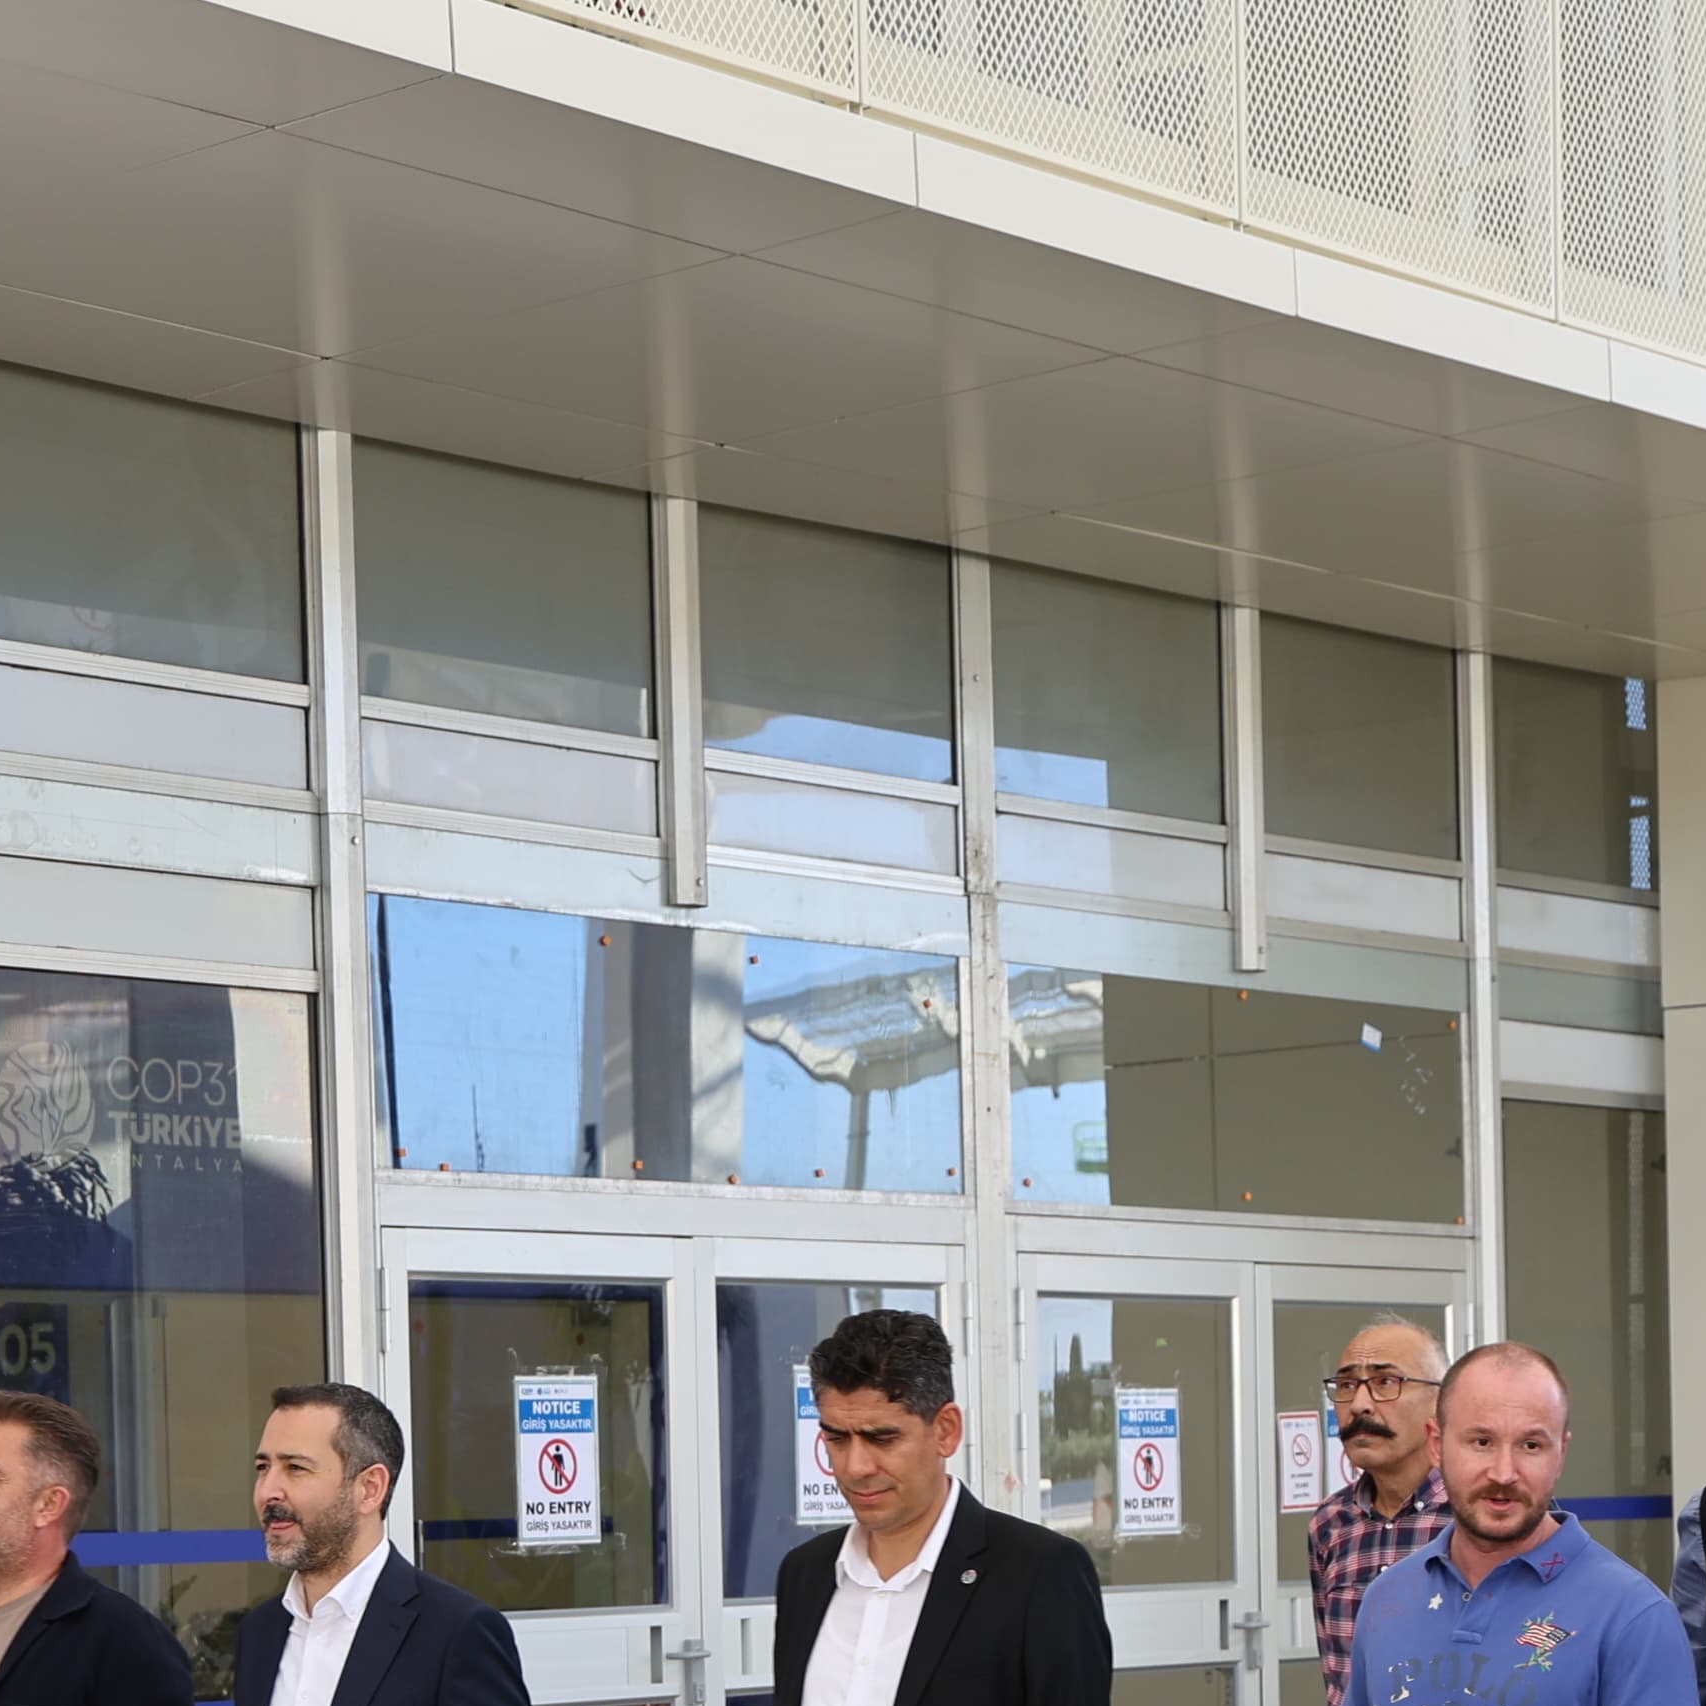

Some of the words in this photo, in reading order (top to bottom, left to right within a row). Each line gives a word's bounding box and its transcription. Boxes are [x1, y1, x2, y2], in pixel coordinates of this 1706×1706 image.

[532, 1401, 582, 1415] NOTICE
[1129, 1409, 1167, 1422] NOTICE
[521, 1416, 547, 1432] GİRİŞ
[549, 1418, 593, 1431] YASAKTIR
[803, 1482, 820, 1496] NO
[525, 1501, 545, 1515] NO
[549, 1500, 592, 1515] ENTRY
[1124, 1498, 1139, 1509] NO
[1141, 1496, 1175, 1509] ENTRY
[526, 1518, 550, 1533] GİRİŞ
[551, 1519, 593, 1531] YASAKTIR
